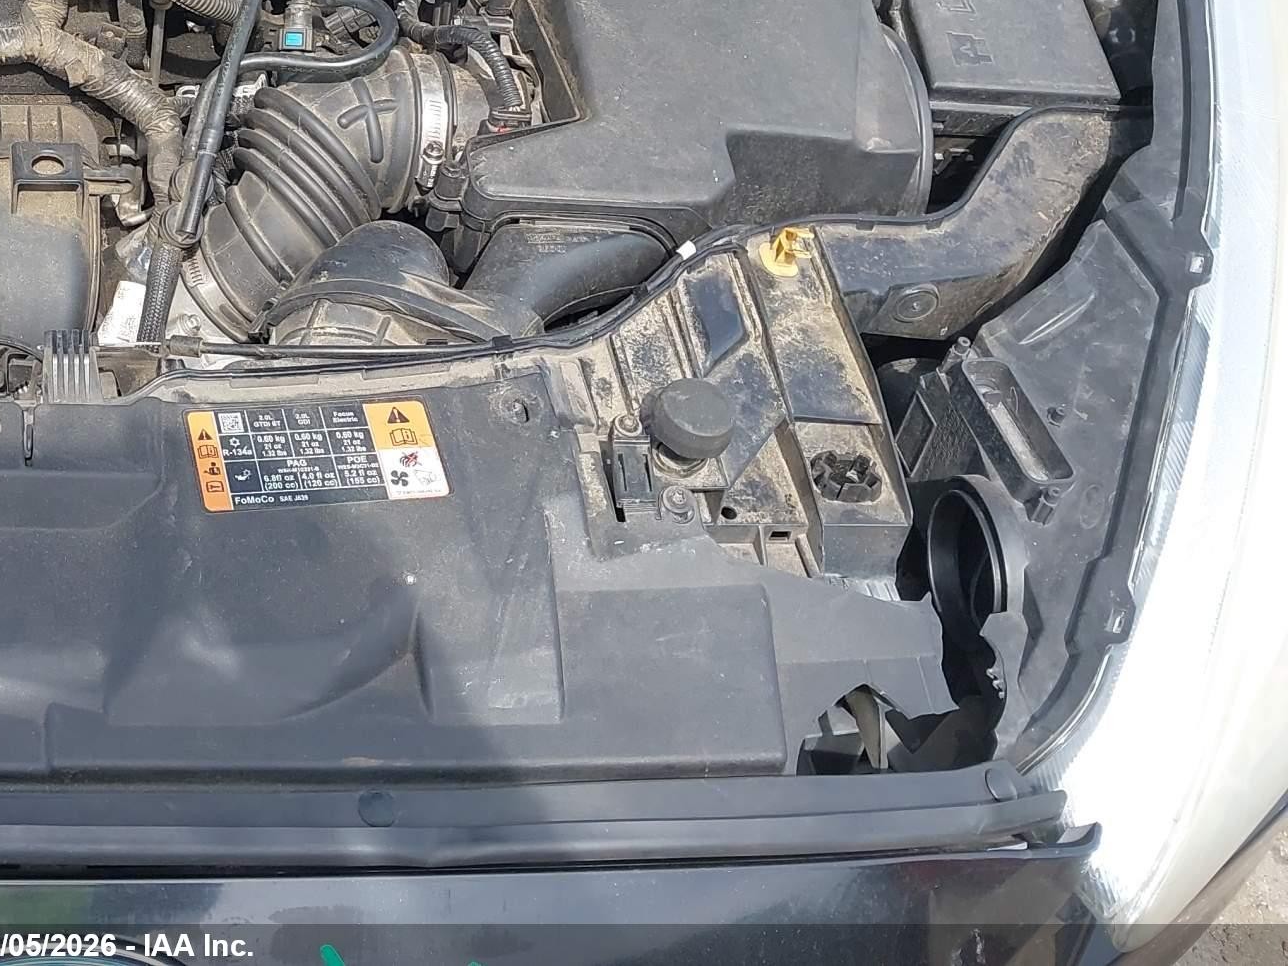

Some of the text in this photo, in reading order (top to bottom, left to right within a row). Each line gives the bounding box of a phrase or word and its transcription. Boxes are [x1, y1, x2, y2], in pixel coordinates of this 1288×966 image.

[275, 434, 285, 443] kg
[312, 432, 323, 441] kg
[354, 431, 364, 439] kg
[304, 480, 322, 488] (120
[347, 476, 380, 486] (155 cc)
[265, 482, 282, 491] (200
[235, 496, 274, 504] FoMoCo
